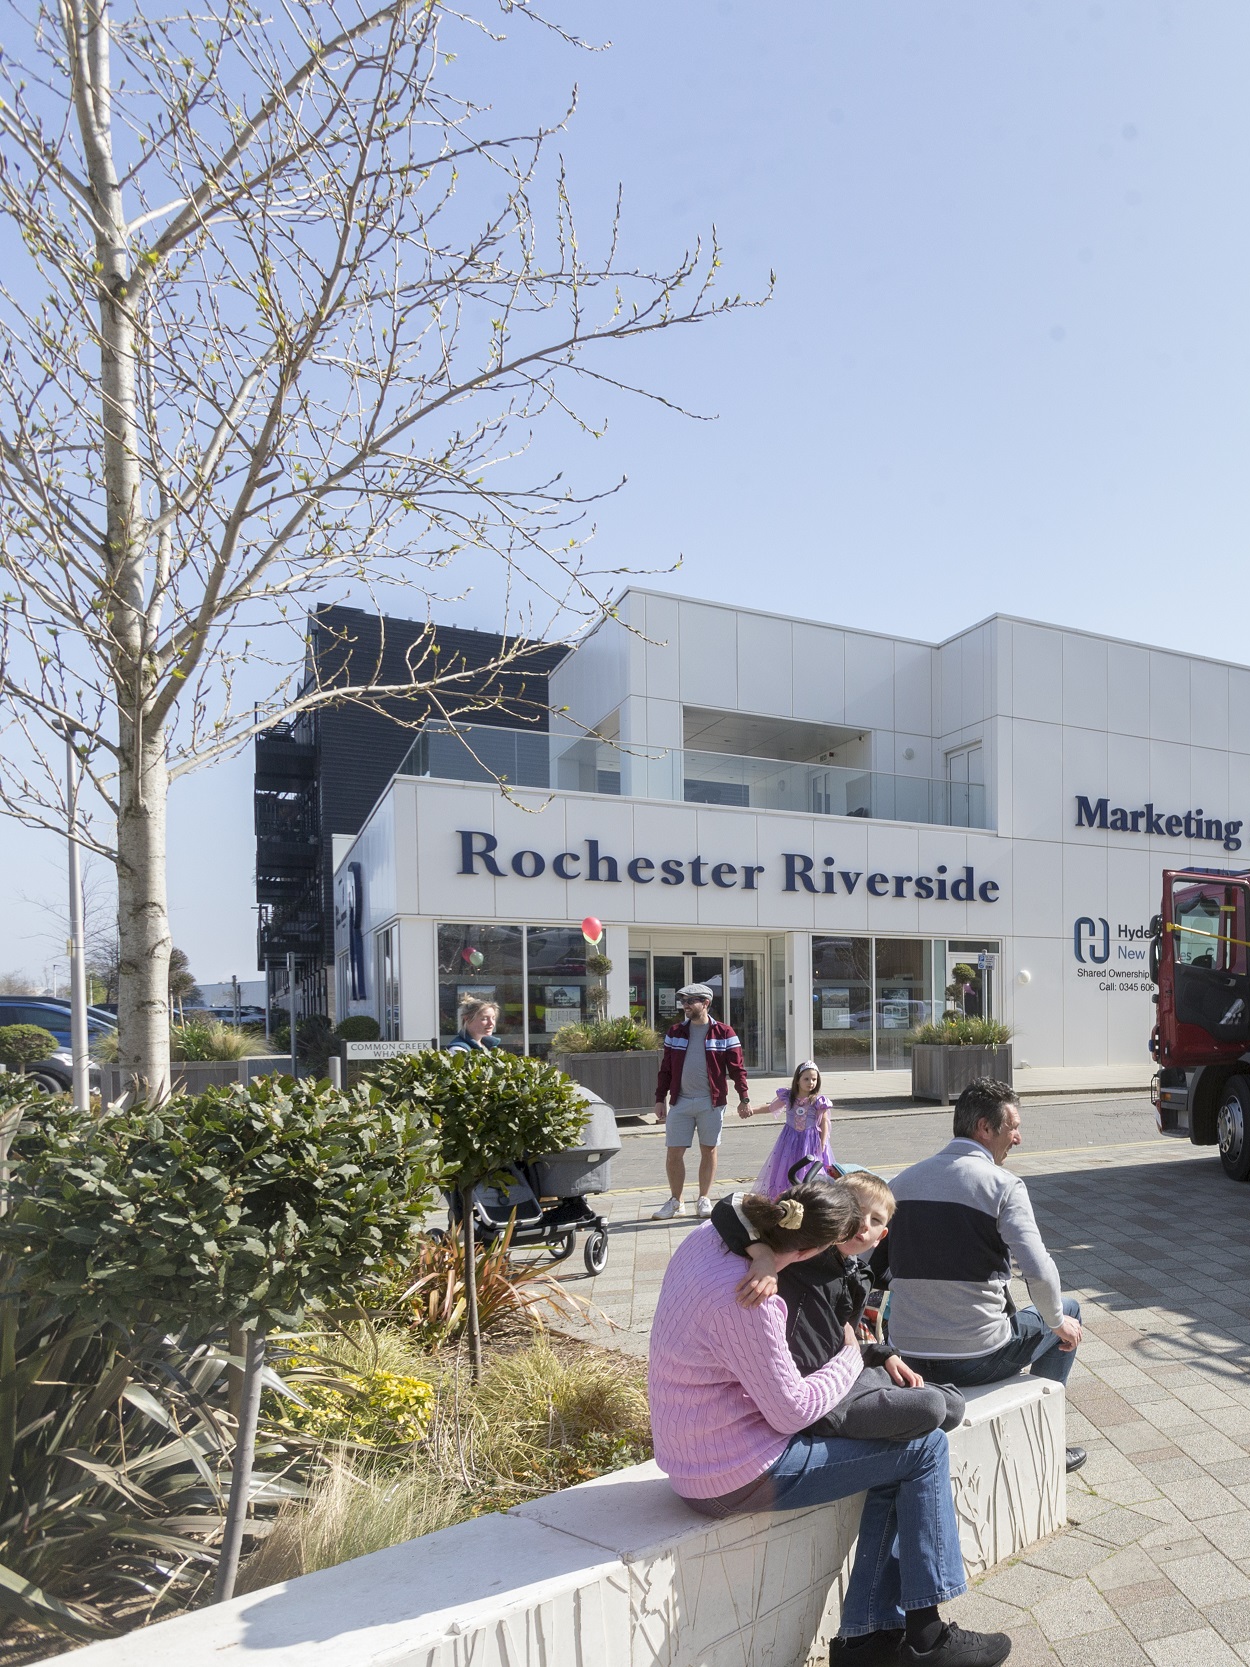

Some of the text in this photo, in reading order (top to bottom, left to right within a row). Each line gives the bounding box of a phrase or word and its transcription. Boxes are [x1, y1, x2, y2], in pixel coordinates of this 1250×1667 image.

[1074, 795, 1243, 850] Marketing
[455, 829, 1001, 902] Rochester Riverside
[1117, 924, 1151, 941] Hyde
[1117, 945, 1146, 960] New
[1077, 968, 1150, 980] Shared Ownership
[1099, 982, 1155, 992] Call: 0345 606
[398, 1042, 429, 1050] CREEK
